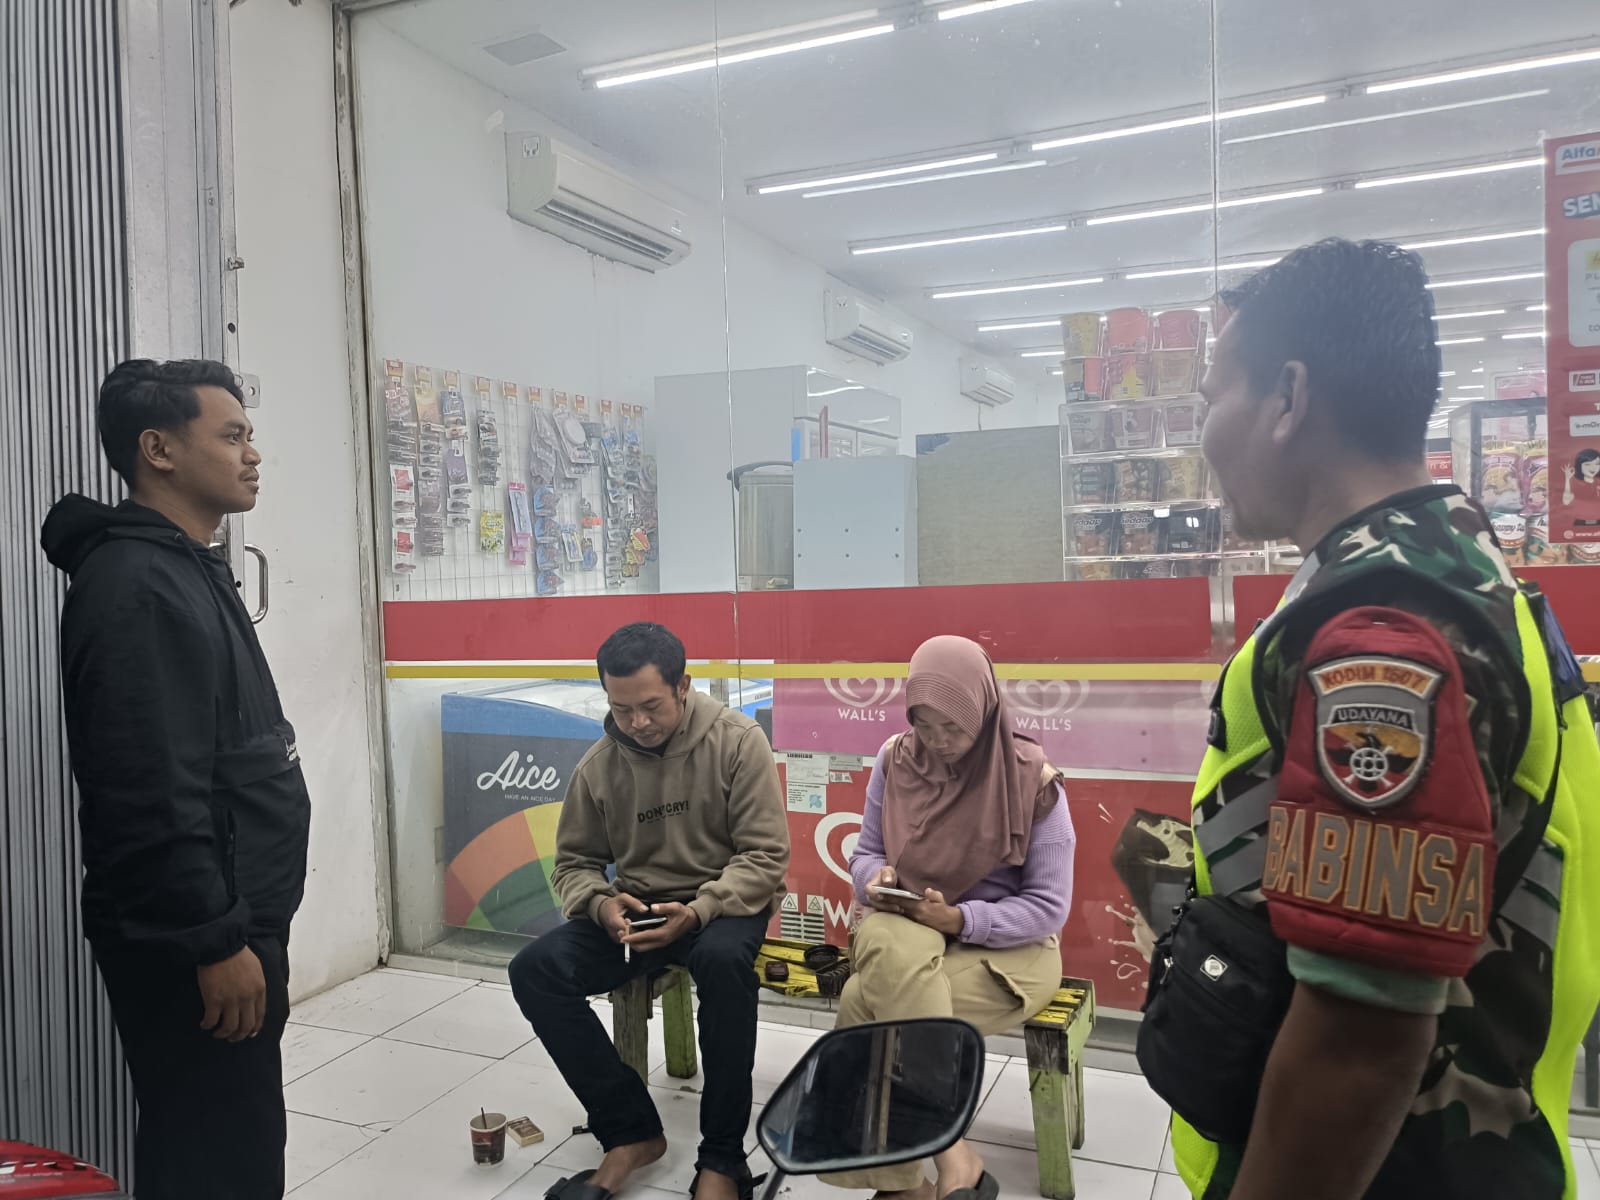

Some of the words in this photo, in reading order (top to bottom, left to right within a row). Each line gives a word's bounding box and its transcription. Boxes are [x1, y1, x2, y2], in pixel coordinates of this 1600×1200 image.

[1562, 145, 1600, 160] Alfa
[1322, 665, 1377, 689] KODIM
[838, 708, 886, 722] WALL'S
[1015, 716, 1072, 731] WALL'S
[1336, 708, 1409, 727] UDAYANA
[476, 751, 561, 790] Aice
[666, 800, 689, 813] CRY!
[1261, 805, 1487, 937] BABINSA
